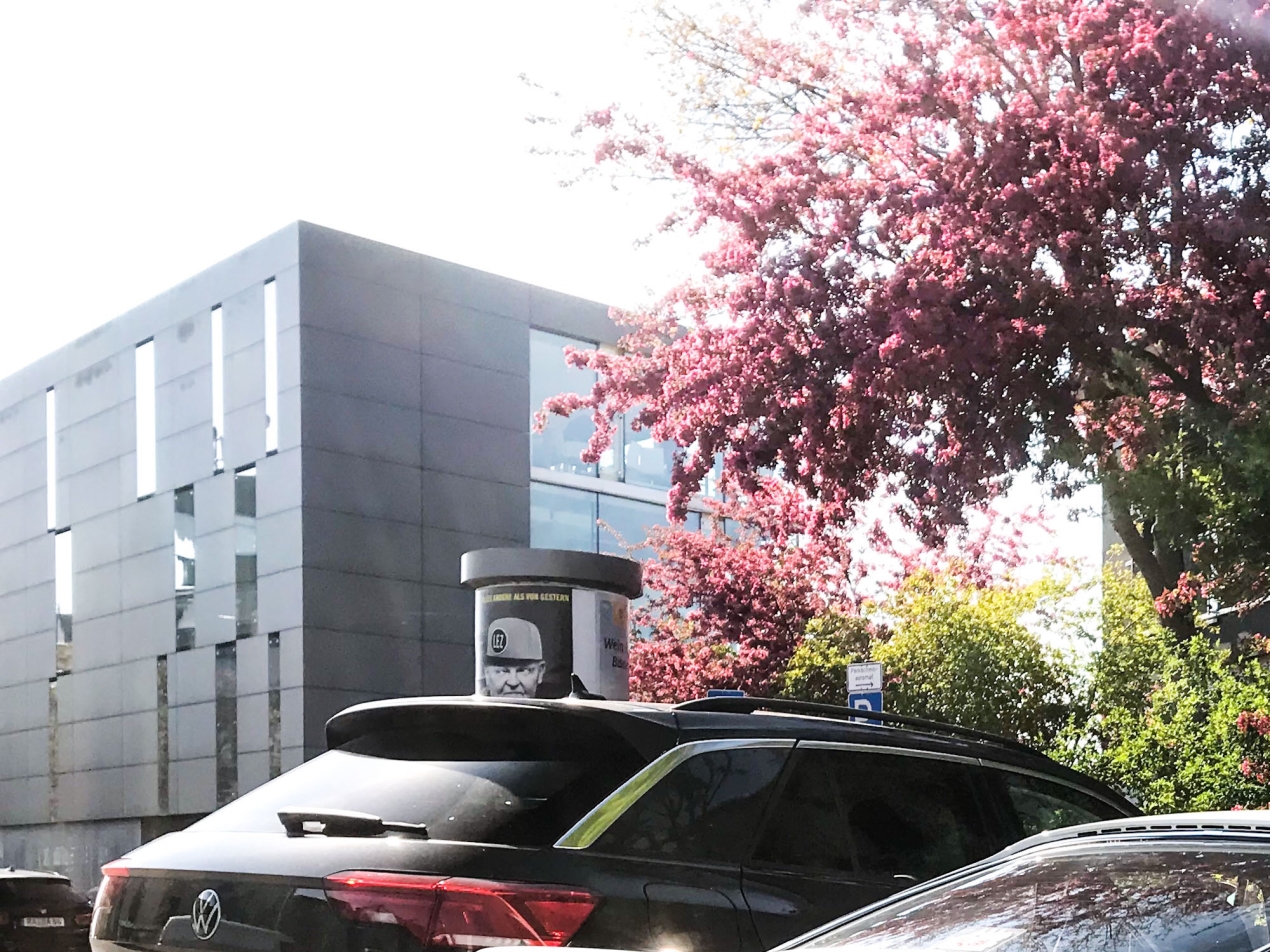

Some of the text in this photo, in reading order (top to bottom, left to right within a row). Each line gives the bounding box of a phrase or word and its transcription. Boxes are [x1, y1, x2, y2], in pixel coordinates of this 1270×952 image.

[513, 592, 525, 600] ALS
[540, 593, 570, 602] GESTERN
[492, 633, 504, 648] LEZ
